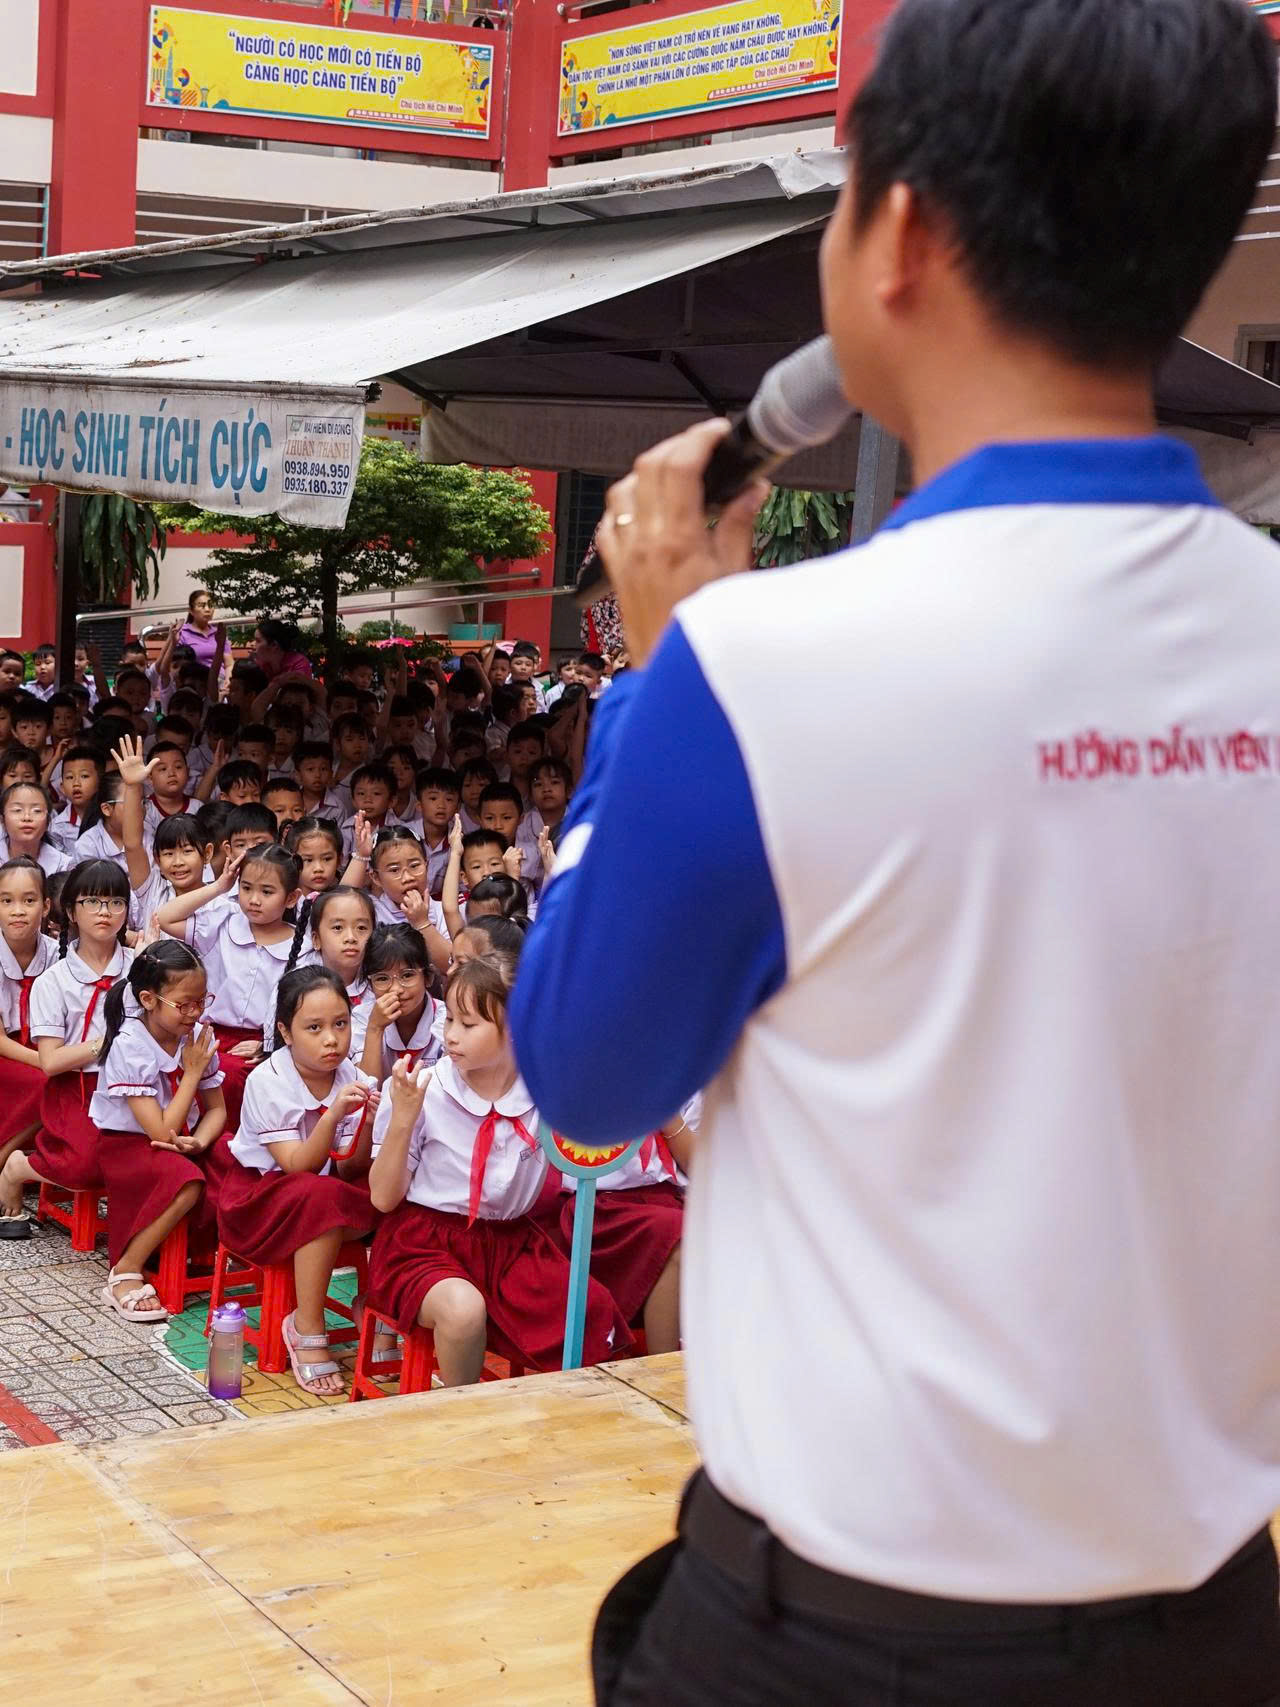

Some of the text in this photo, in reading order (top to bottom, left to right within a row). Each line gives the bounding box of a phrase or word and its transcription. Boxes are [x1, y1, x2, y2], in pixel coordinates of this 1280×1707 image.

[594, 67, 606, 78] VIỆT
[607, 66, 620, 76] NAM
[650, 57, 660, 67] VAI
[661, 54, 672, 65] VỚI
[673, 50, 686, 63] CÁC
[710, 41, 728, 55] QUỐC
[767, 30, 785, 44] ĐƯỢC
[787, 27, 801, 39] HAY
[643, 41, 656, 54] VIỆT
[658, 38, 672, 49] NAM
[722, 23, 740, 35] VANG
[741, 20, 755, 31] HAY
[279, 39, 295, 58] CÓ
[299, 44, 324, 63] HỌC
[328, 45, 351, 64] MỚI
[355, 48, 371, 67] CÓ
[376, 49, 401, 70] TIẾN
[406, 54, 421, 76] BỘ
[639, 73, 653, 87] MỘT
[692, 62, 709, 75] CÔNG
[711, 60, 724, 73] HỌC
[726, 56, 739, 71] TẬP
[740, 53, 753, 66] CỦA
[755, 50, 769, 63] CÁC
[799, 60, 813, 71] Minh
[245, 61, 279, 82] CÀNG
[283, 67, 308, 87] HỌC
[312, 69, 346, 89] CÀNG
[350, 72, 376, 93] TIẾN
[448, 104, 463, 114] Minh
[5, 437, 12, 448] -
[19, 407, 66, 480] HỌC
[72, 410, 130, 477] SINH
[139, 398, 200, 485] TÍCH
[209, 407, 271, 505] CỰC
[284, 460, 350, 479] 0938.894.950
[284, 476, 348, 496] 0935.180.337
